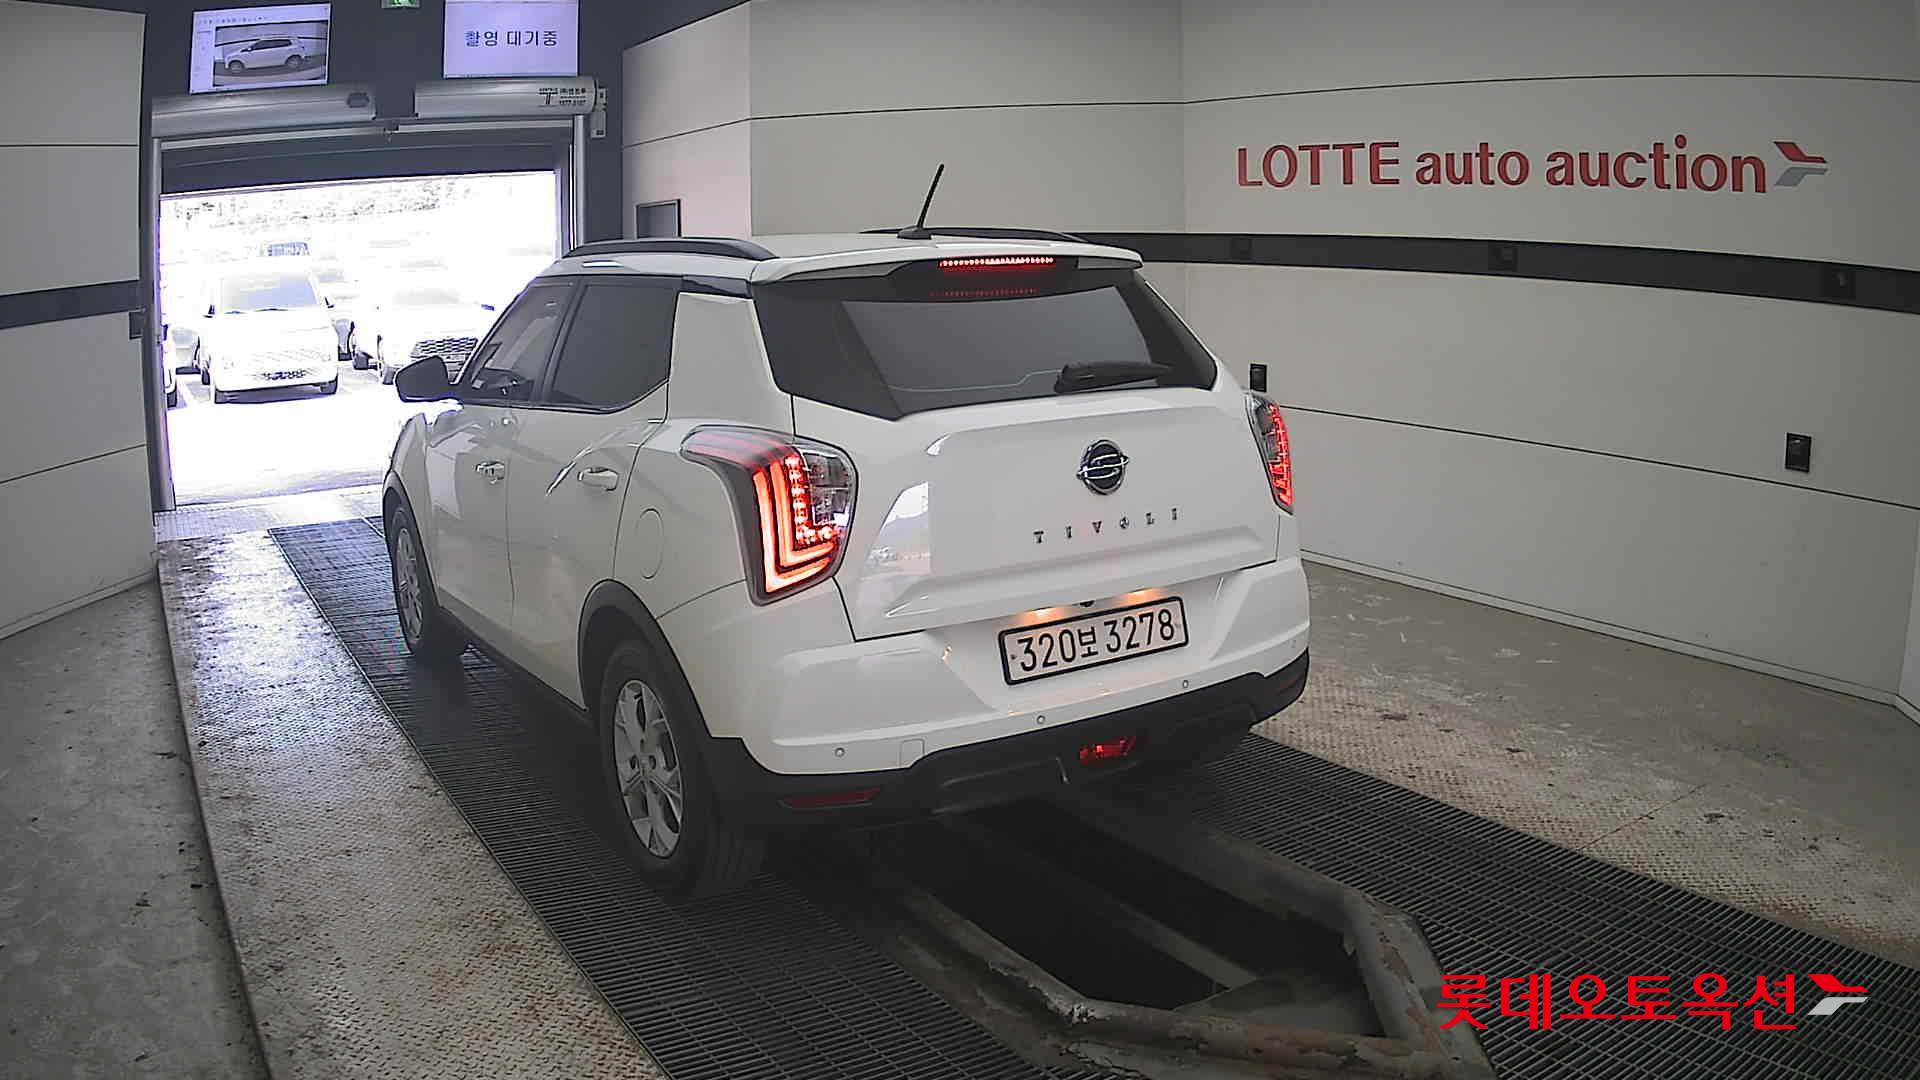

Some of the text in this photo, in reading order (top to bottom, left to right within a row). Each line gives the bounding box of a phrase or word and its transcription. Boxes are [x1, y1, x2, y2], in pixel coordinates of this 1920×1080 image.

[506, 30, 558, 47] 대기중
[1238, 134, 1767, 194] LOTTE auto auction
[1033, 507, 1178, 544] TIVOLI
[1104, 609, 1175, 653] 3278
